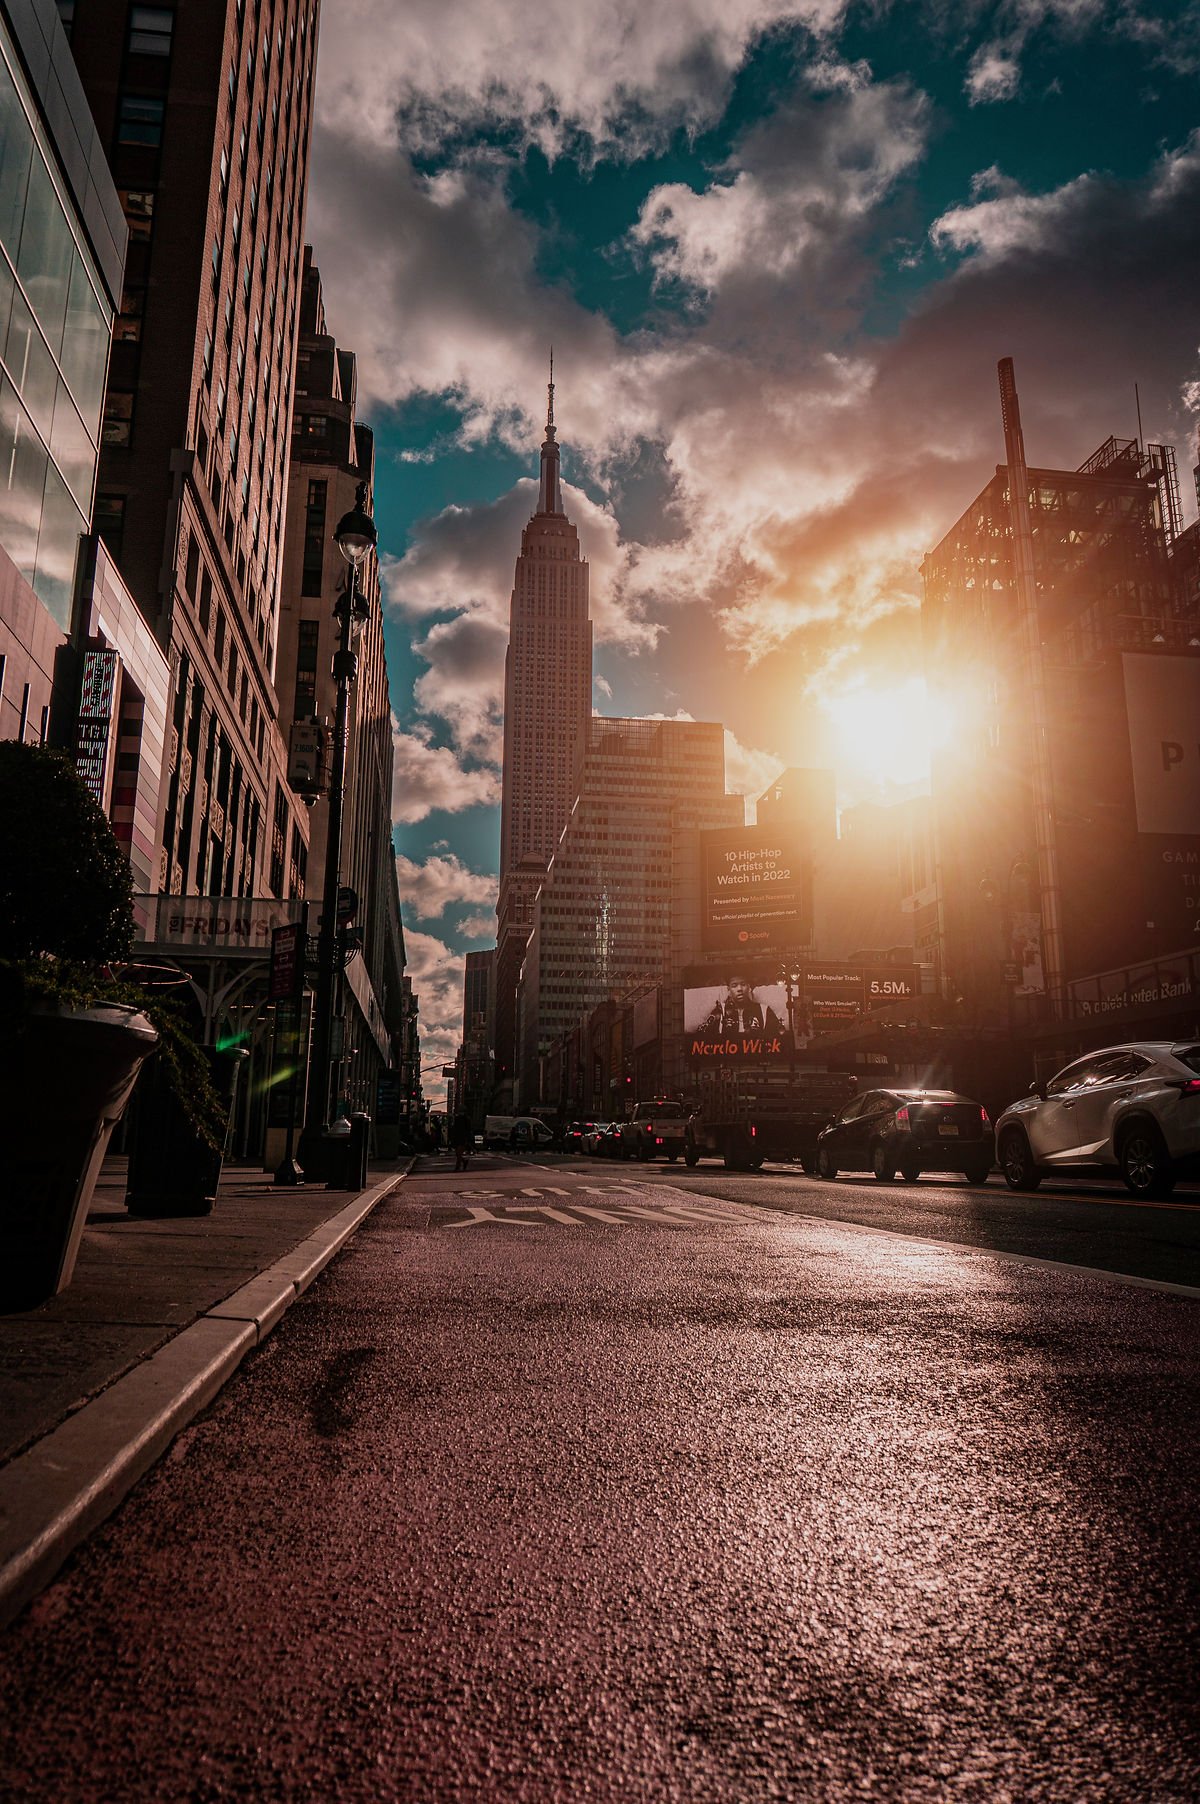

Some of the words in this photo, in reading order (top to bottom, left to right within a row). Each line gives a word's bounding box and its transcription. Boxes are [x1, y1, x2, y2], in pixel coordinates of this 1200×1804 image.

[78, 724, 108, 739] TGI
[725, 851, 737, 861] 10
[739, 849, 782, 861] Hip-Hop
[731, 861, 763, 873] Artists
[765, 860, 776, 869] to
[717, 873, 750, 885] Watch
[751, 872, 761, 882] in
[763, 869, 791, 881] 2022
[1182, 874, 1200, 886] TI
[713, 896, 742, 905] Presented
[742, 896, 750, 904] by
[169, 916, 180, 934] TGI
[181, 917, 268, 936] FRIDAYS
[749, 931, 770, 939] Spotify
[822, 974, 844, 982] Popular
[870, 981, 911, 994] 5.5M+
